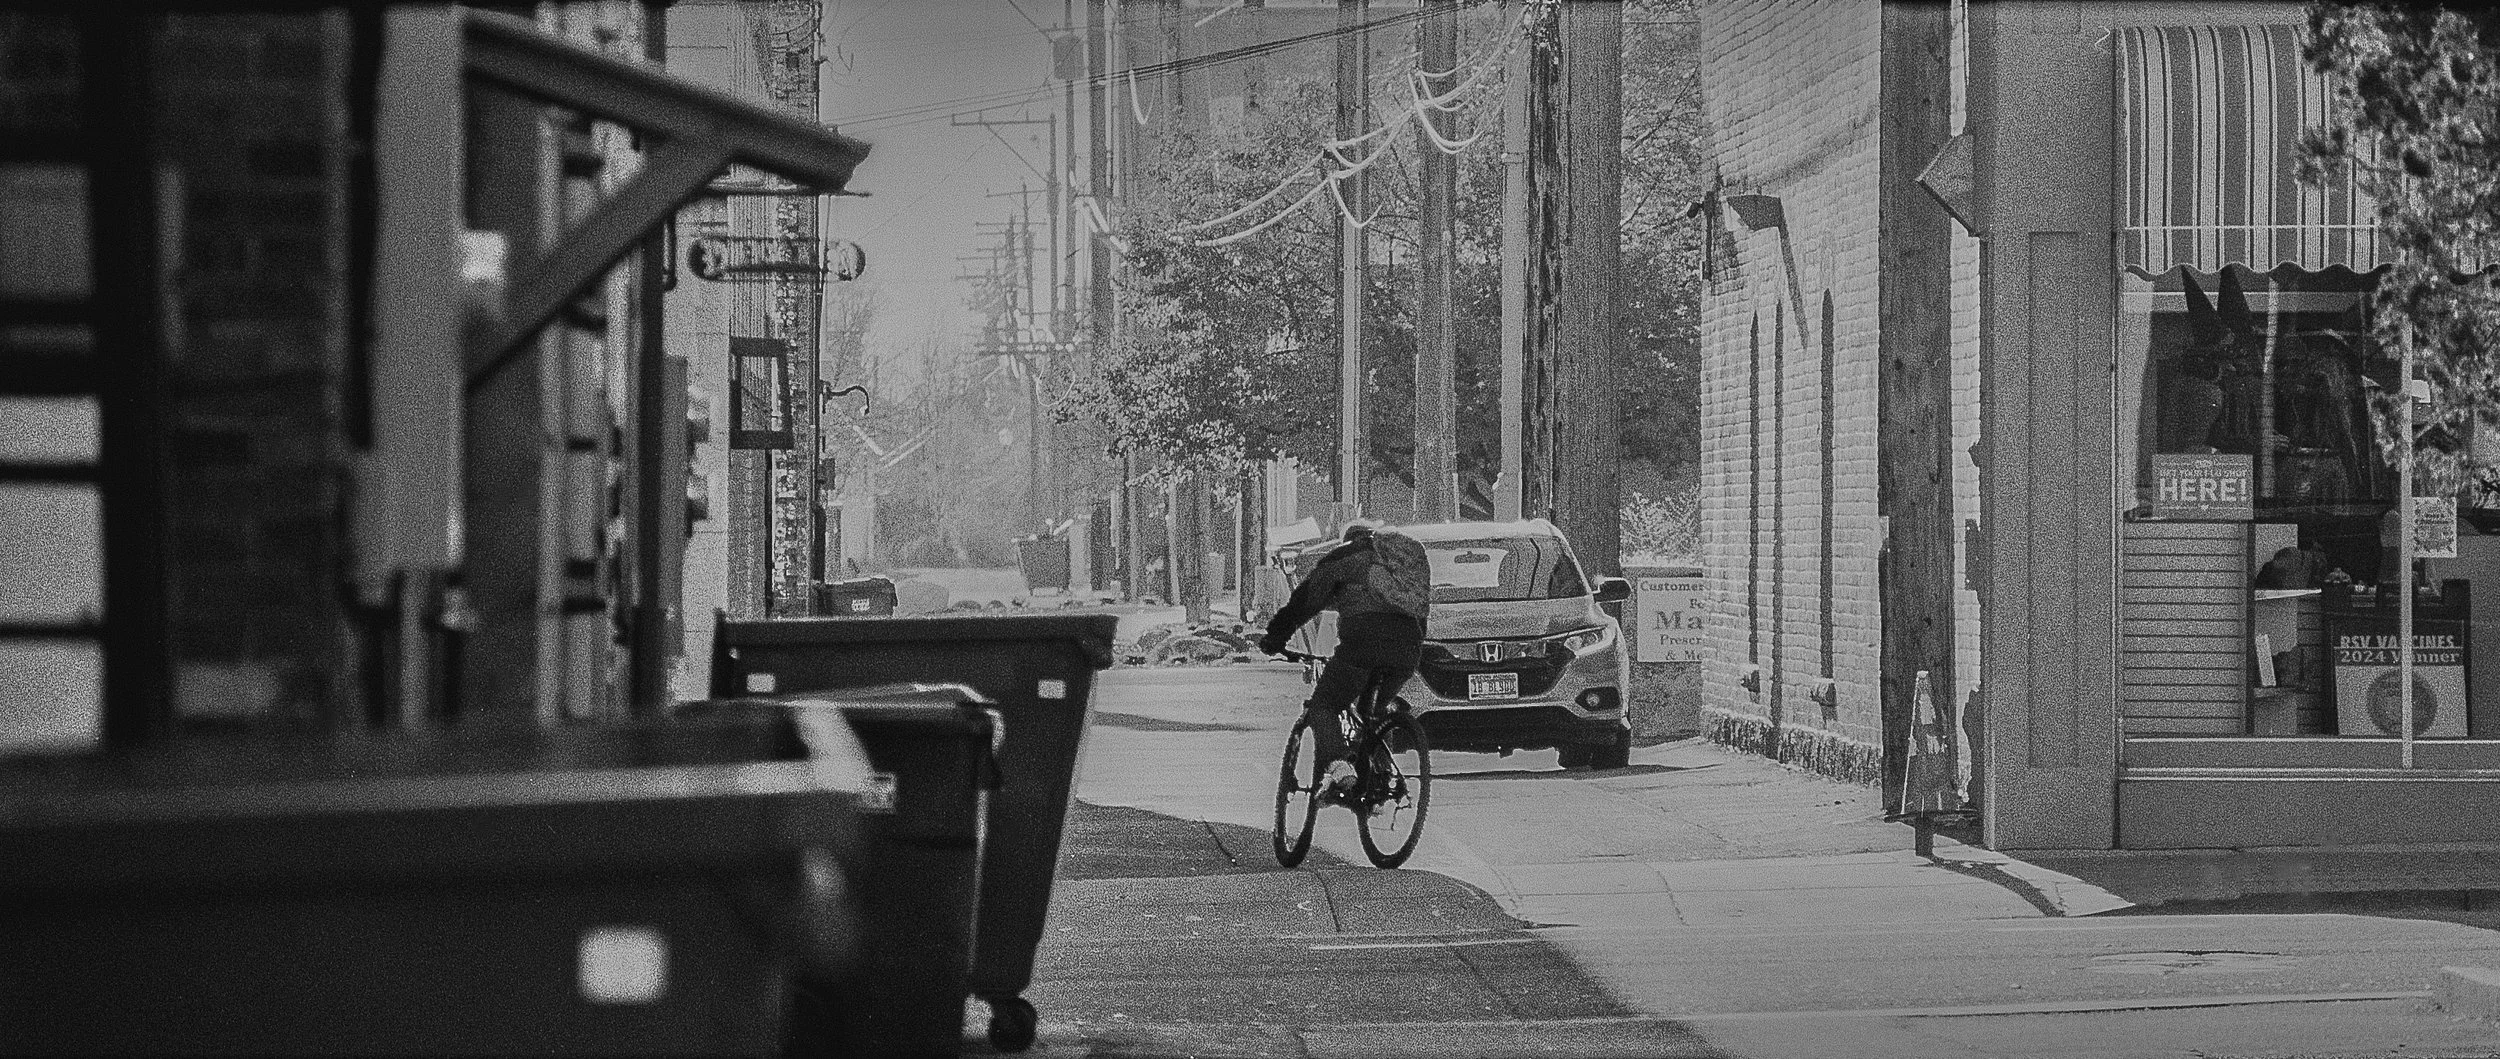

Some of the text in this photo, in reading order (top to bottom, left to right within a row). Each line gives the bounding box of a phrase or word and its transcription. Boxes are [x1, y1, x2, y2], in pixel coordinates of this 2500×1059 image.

[2160, 478, 2247, 501] HERE!
[1640, 580, 1704, 591] Customer
[1652, 611, 1704, 630] Ma
[2340, 635, 2455, 648] RSV VACINES
[1665, 650, 1676, 660] &
[2340, 650, 2387, 662] 2024
